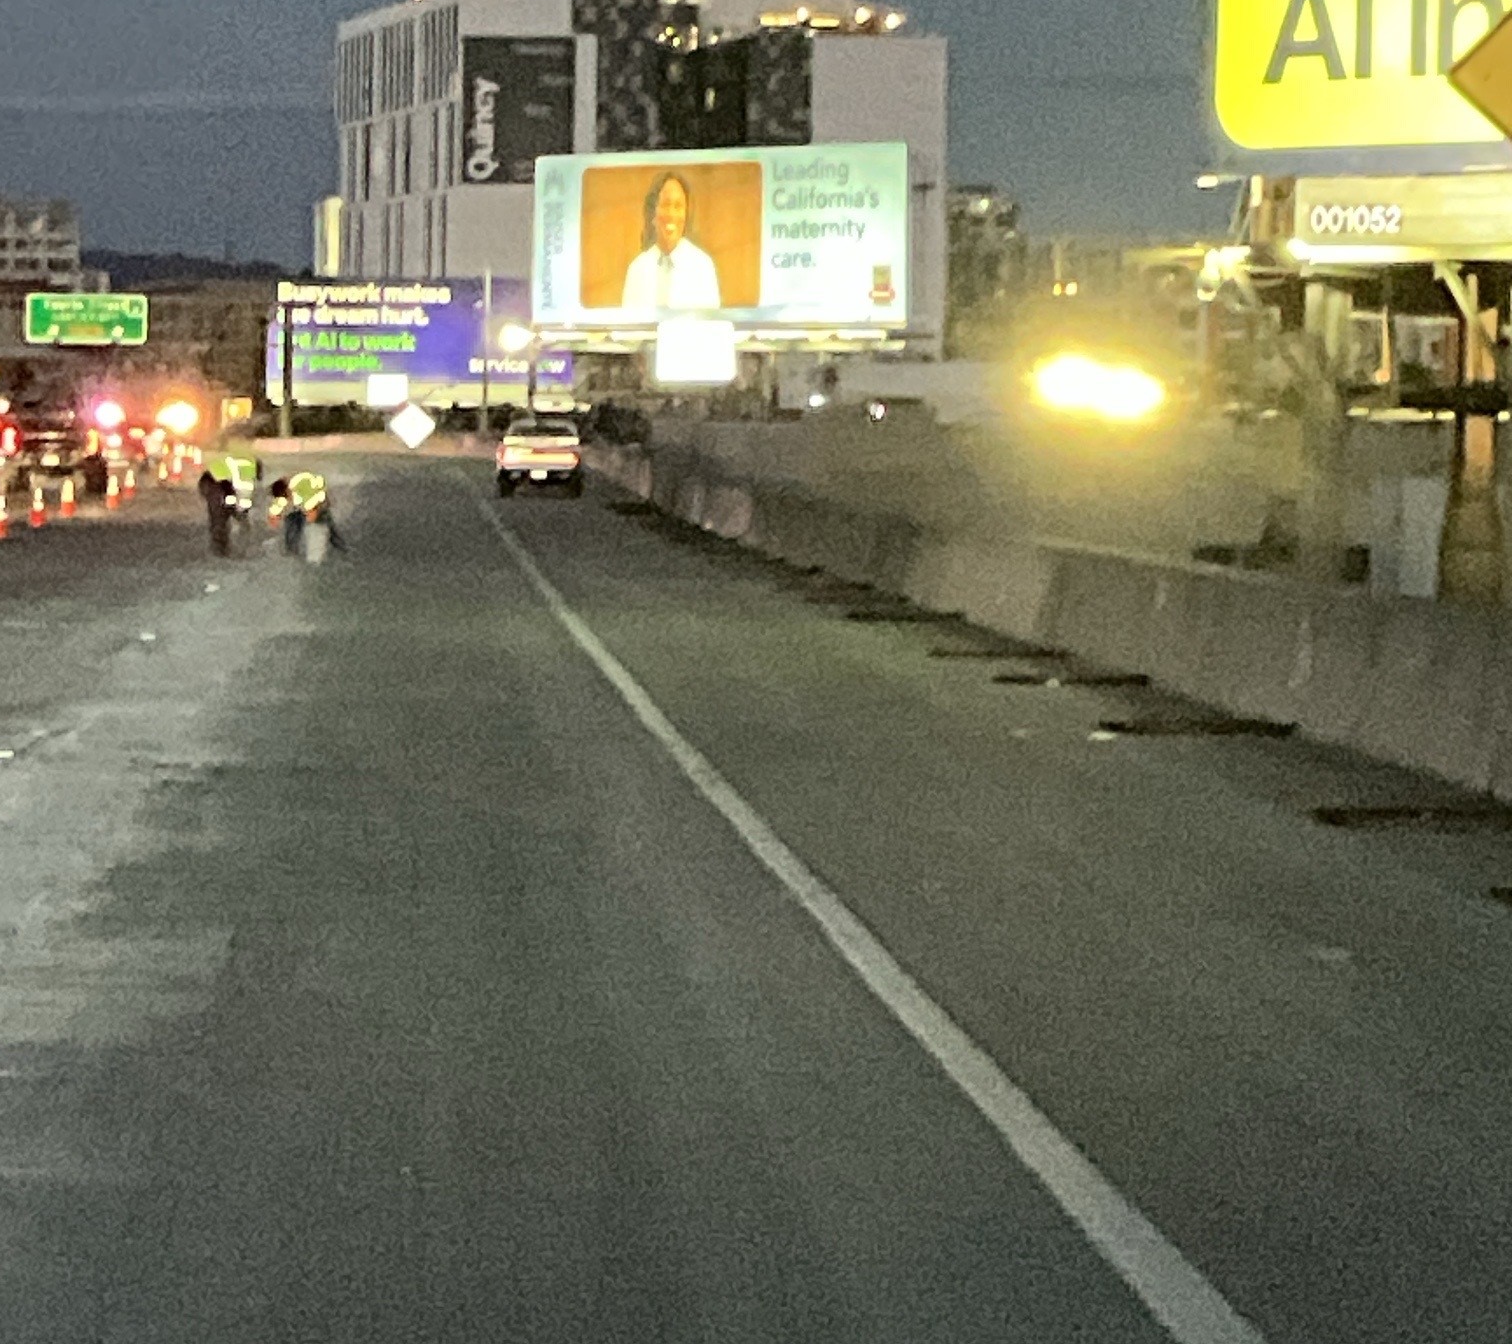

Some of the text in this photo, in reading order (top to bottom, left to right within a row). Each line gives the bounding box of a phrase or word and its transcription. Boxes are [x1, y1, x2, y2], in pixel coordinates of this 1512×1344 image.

[467, 76, 501, 181] Quincy
[772, 156, 850, 186] Leading
[772, 185, 880, 211] California's
[770, 219, 866, 242] maternity
[1310, 204, 1402, 234] 001052
[770, 252, 817, 269] care.
[277, 281, 452, 305] Busywork makes
[313, 305, 379, 325] dream
[381, 305, 430, 326] hurt.
[315, 331, 338, 349] AI
[338, 331, 361, 350] to
[362, 331, 416, 352] work
[307, 352, 383, 373] people.
